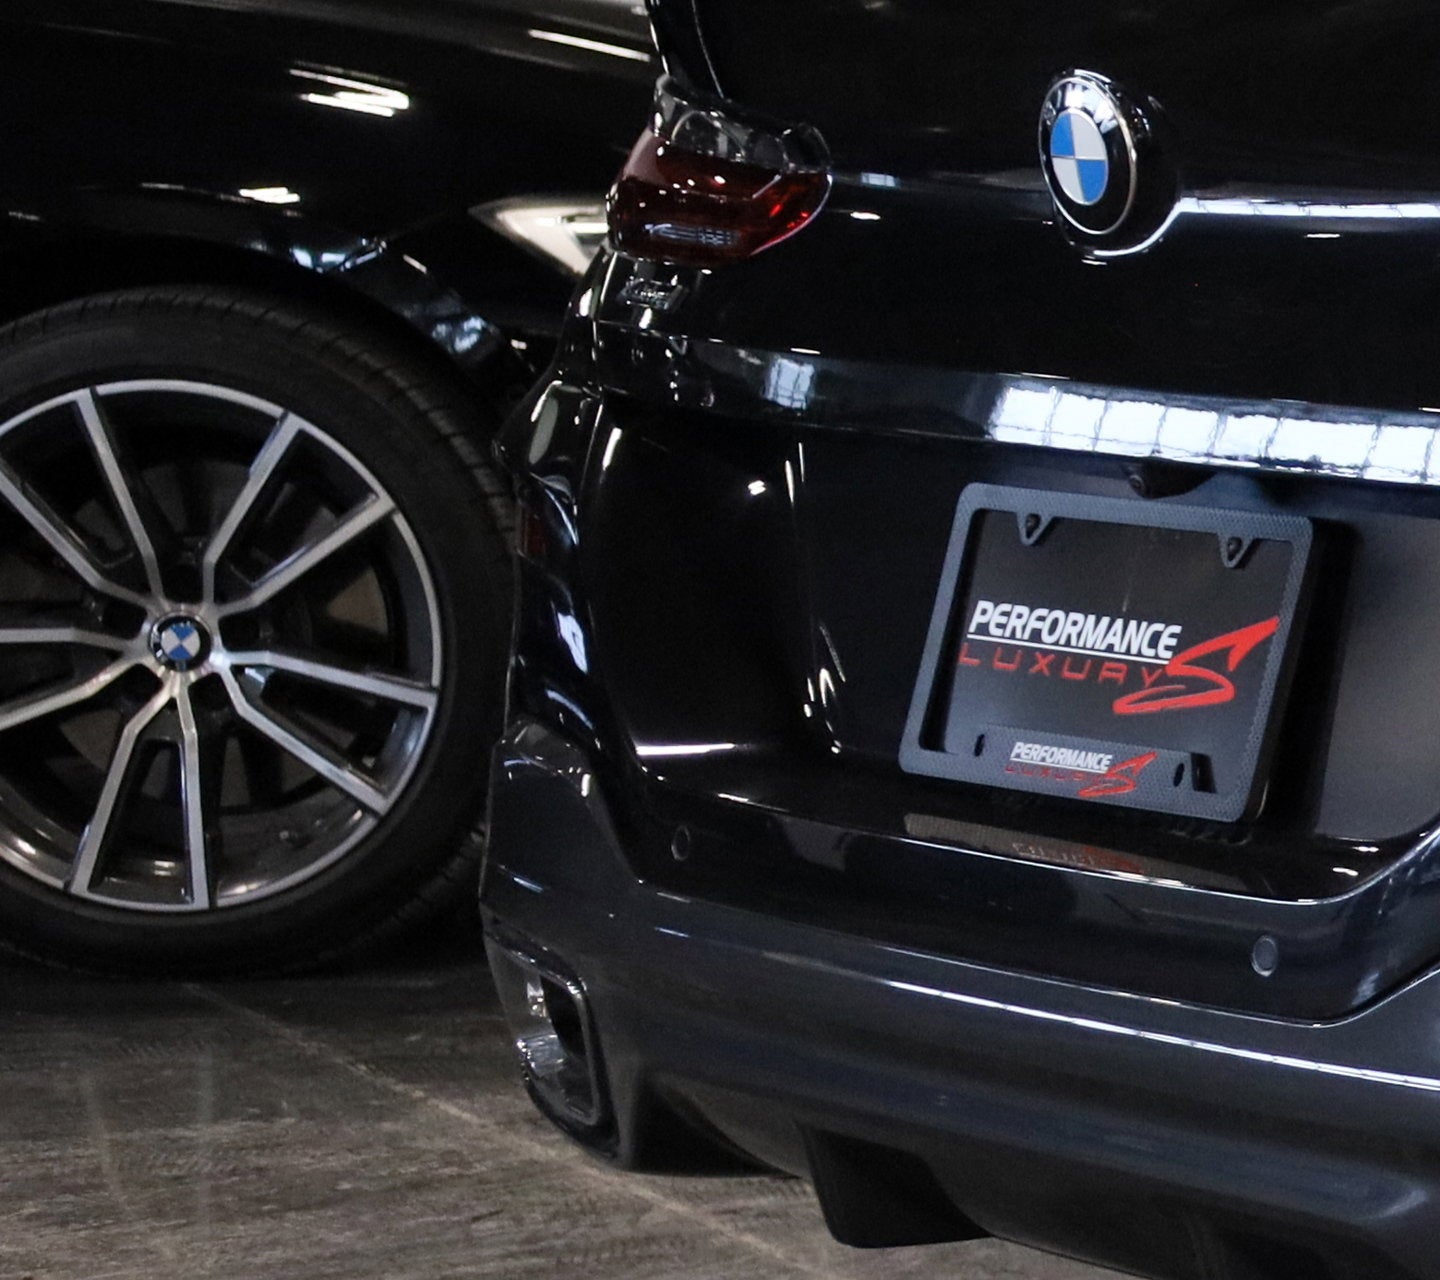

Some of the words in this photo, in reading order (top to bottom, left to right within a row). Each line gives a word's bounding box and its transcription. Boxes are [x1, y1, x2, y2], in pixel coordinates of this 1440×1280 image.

[968, 600, 1182, 659] PERFORMANCE
[957, 642, 1165, 688] LUXURY
[1010, 741, 1113, 770] PERFORMANCE
